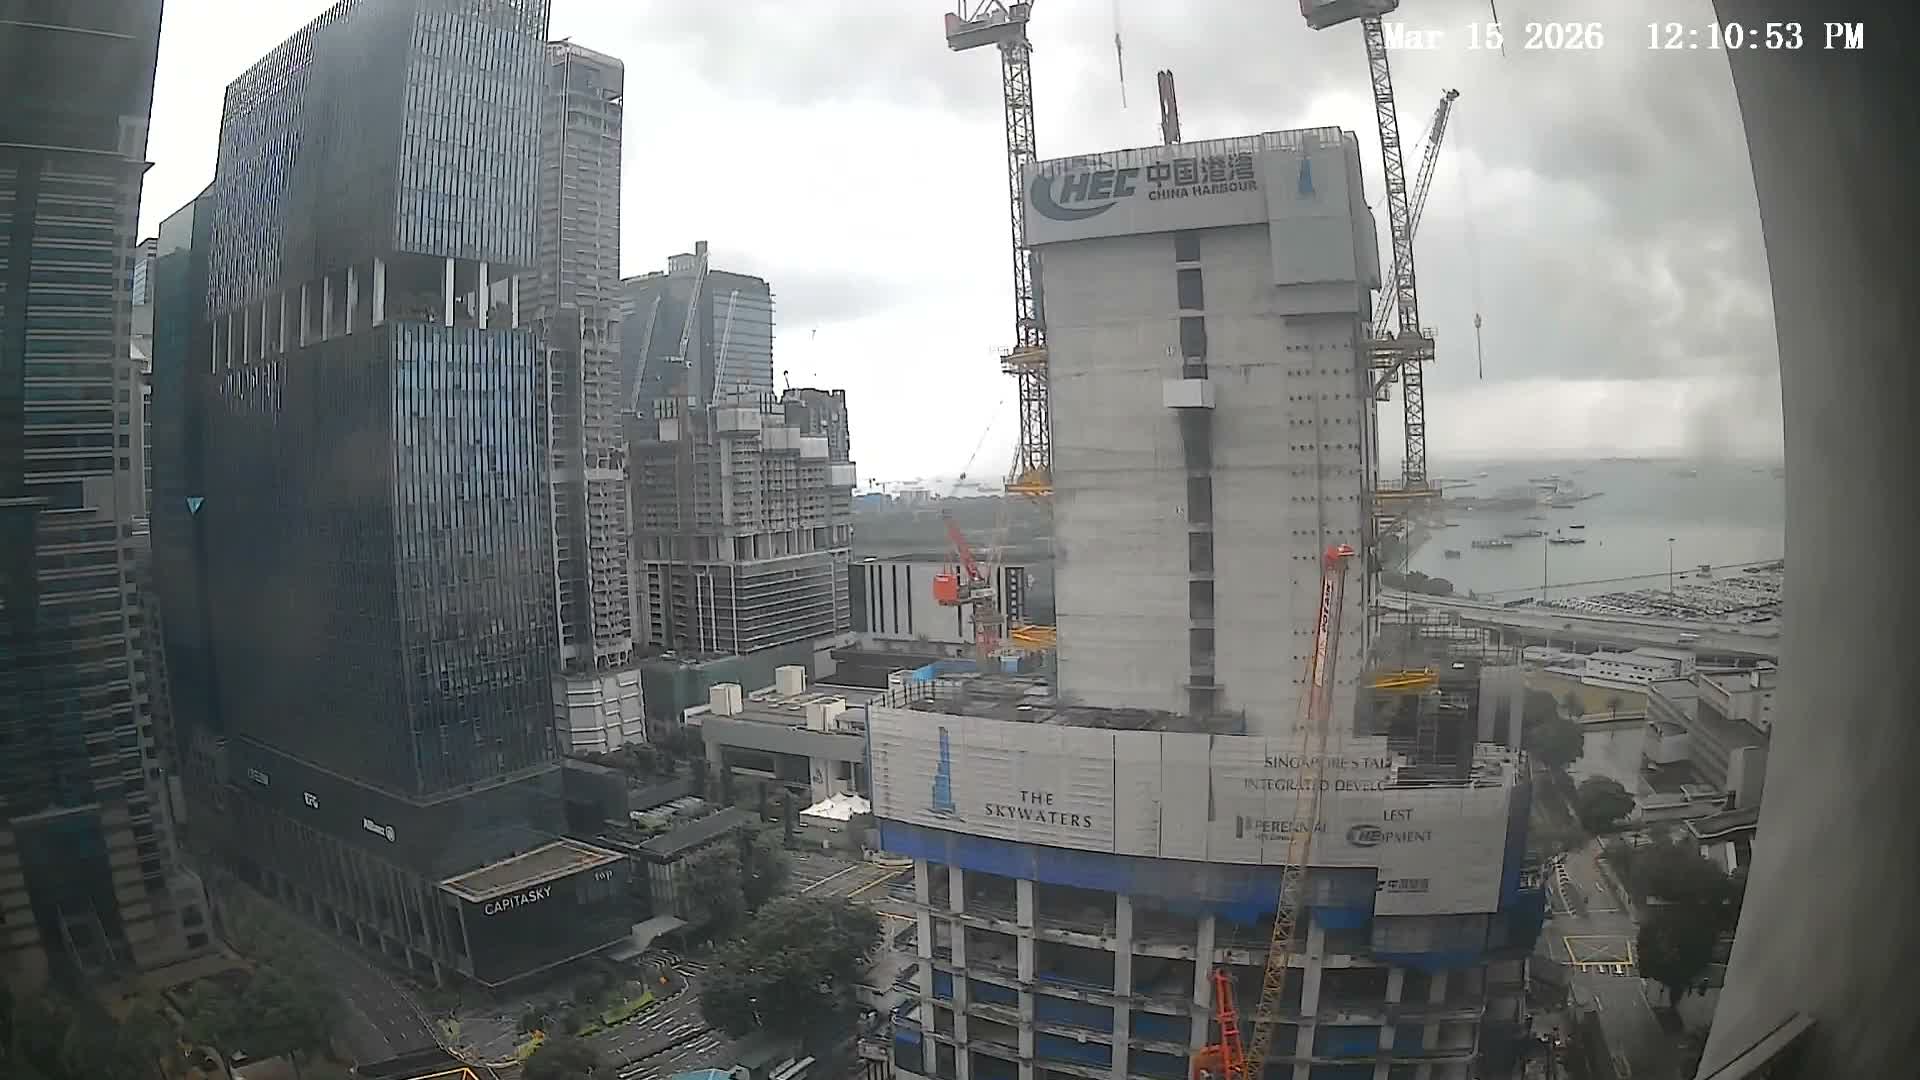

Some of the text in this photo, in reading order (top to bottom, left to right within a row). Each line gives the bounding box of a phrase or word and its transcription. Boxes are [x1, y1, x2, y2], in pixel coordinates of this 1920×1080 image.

[1146, 151, 1255, 187] 中国港湾
[1148, 180, 1258, 201] CHINA HARBOUR
[1020, 790, 1053, 805] THE
[985, 804, 1092, 827] SKYWATERS
[483, 886, 552, 915] CAPITASKY
